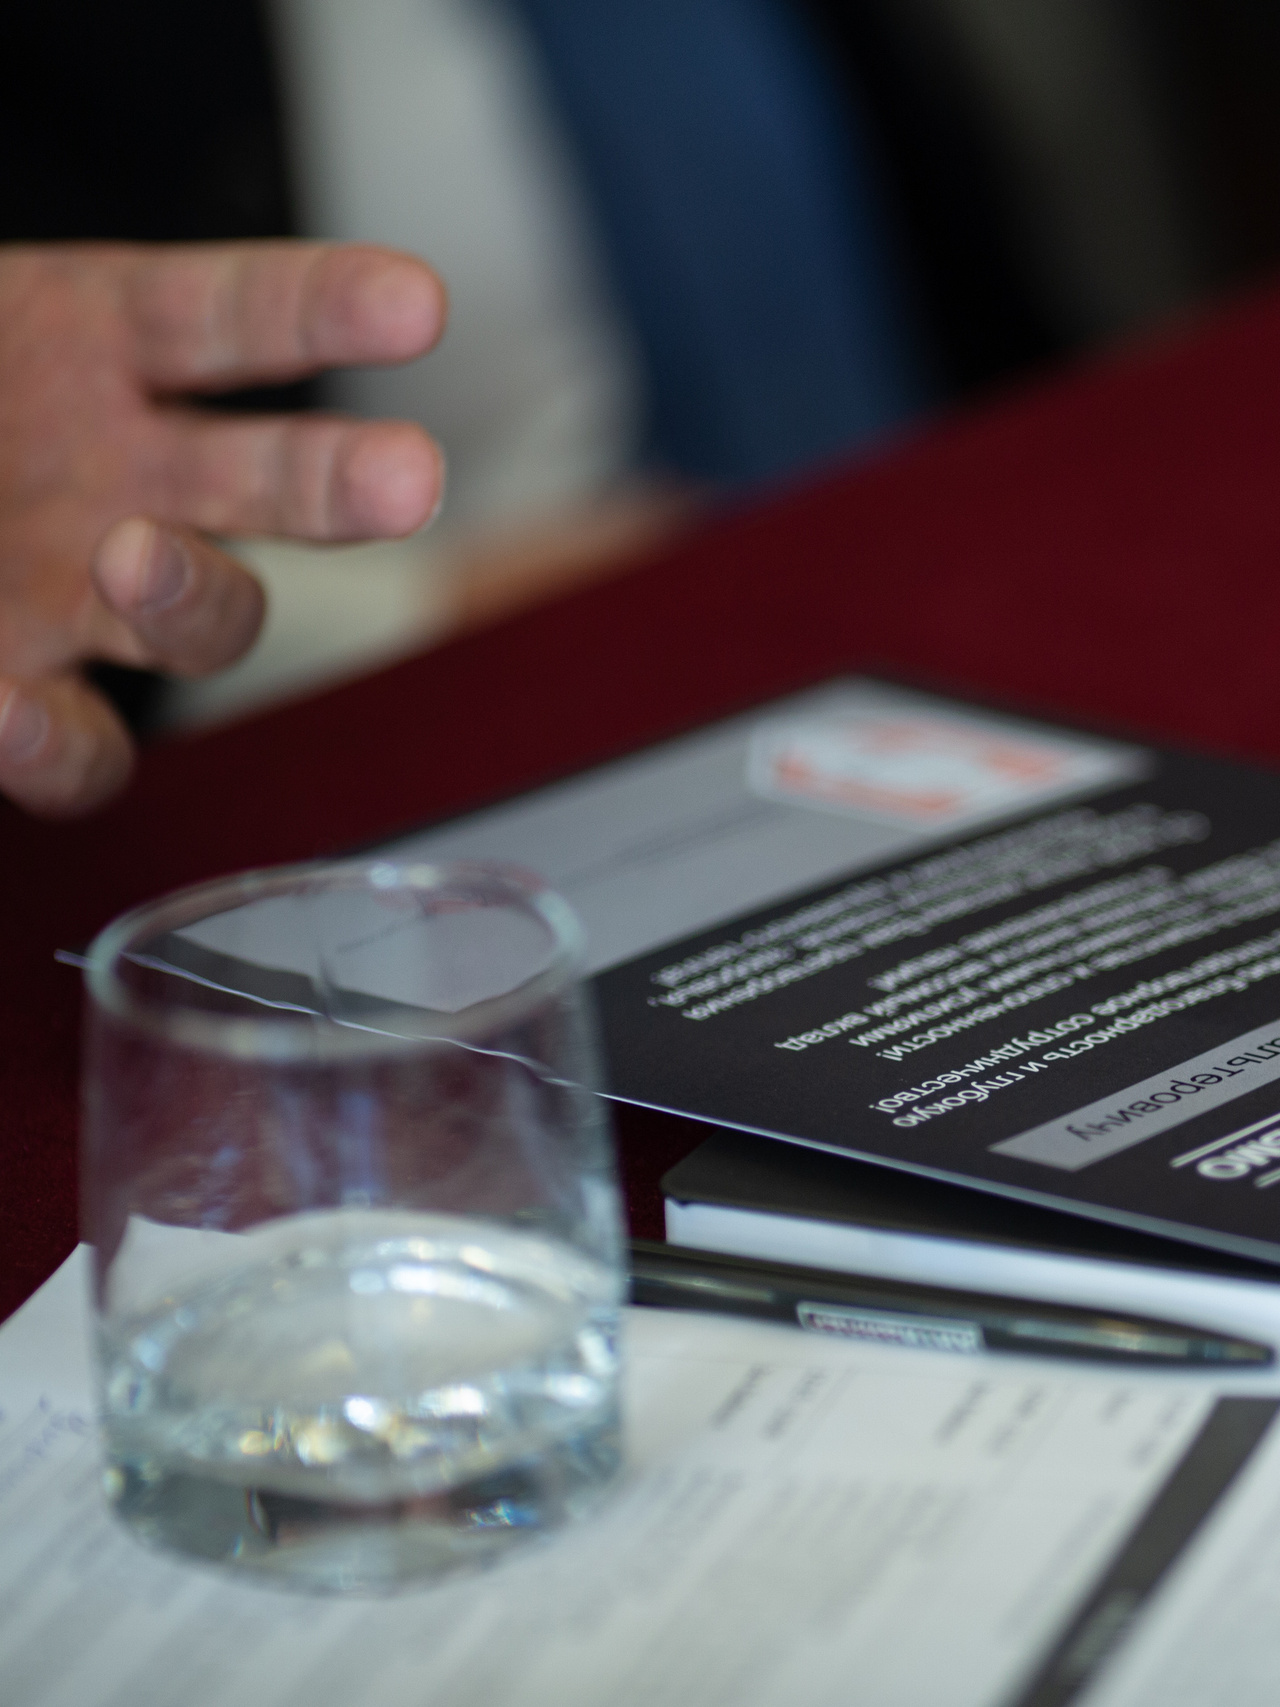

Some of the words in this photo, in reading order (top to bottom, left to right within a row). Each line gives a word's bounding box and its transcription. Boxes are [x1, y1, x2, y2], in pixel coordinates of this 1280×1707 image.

[774, 1012, 871, 1051] вклад
[1043, 973, 1249, 1061] благодарность
[869, 1013, 1097, 1114] сотрудничество!
[1019, 1059, 1049, 1074] и
[893, 1067, 1026, 1127] глубокую
